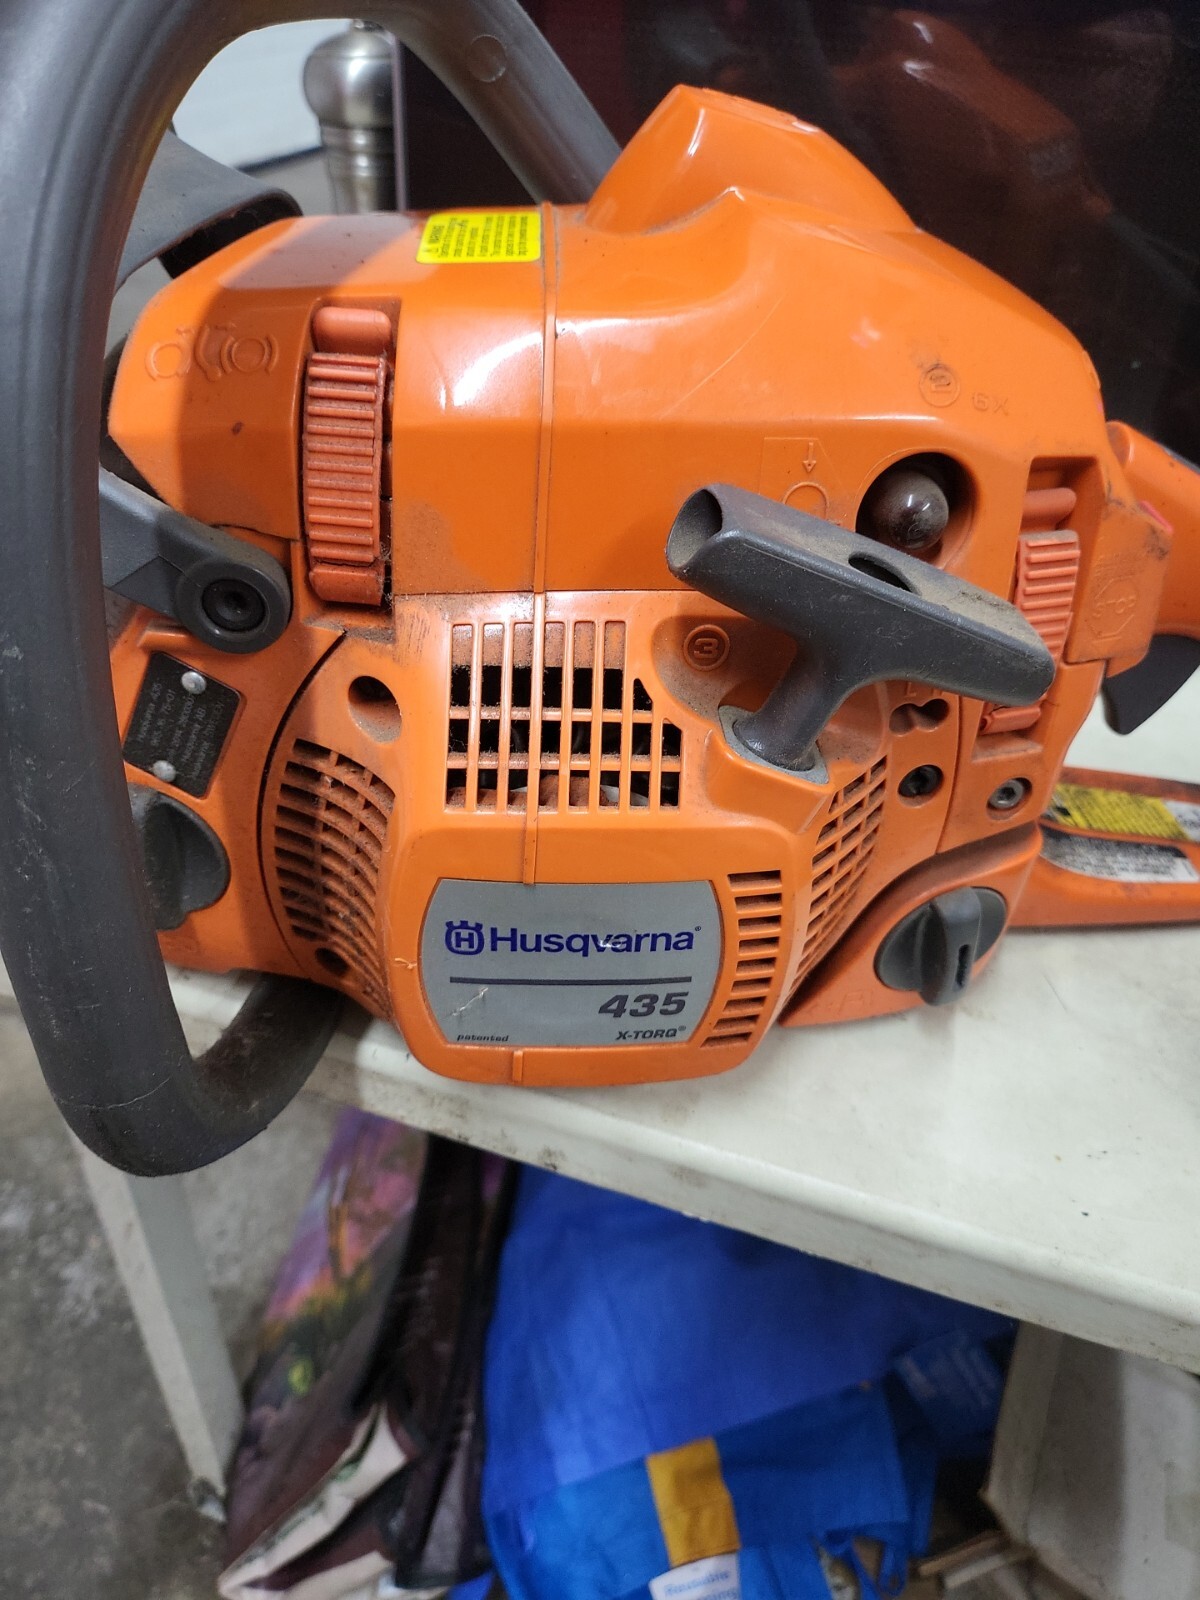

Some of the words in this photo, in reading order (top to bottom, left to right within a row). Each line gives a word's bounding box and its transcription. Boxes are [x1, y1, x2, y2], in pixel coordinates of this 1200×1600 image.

[693, 637, 719, 659] 3
[490, 926, 695, 957] Husqvarna
[598, 991, 689, 1018] 435
[456, 1033, 510, 1042] patented
[614, 1027, 679, 1041] X-TORQ
